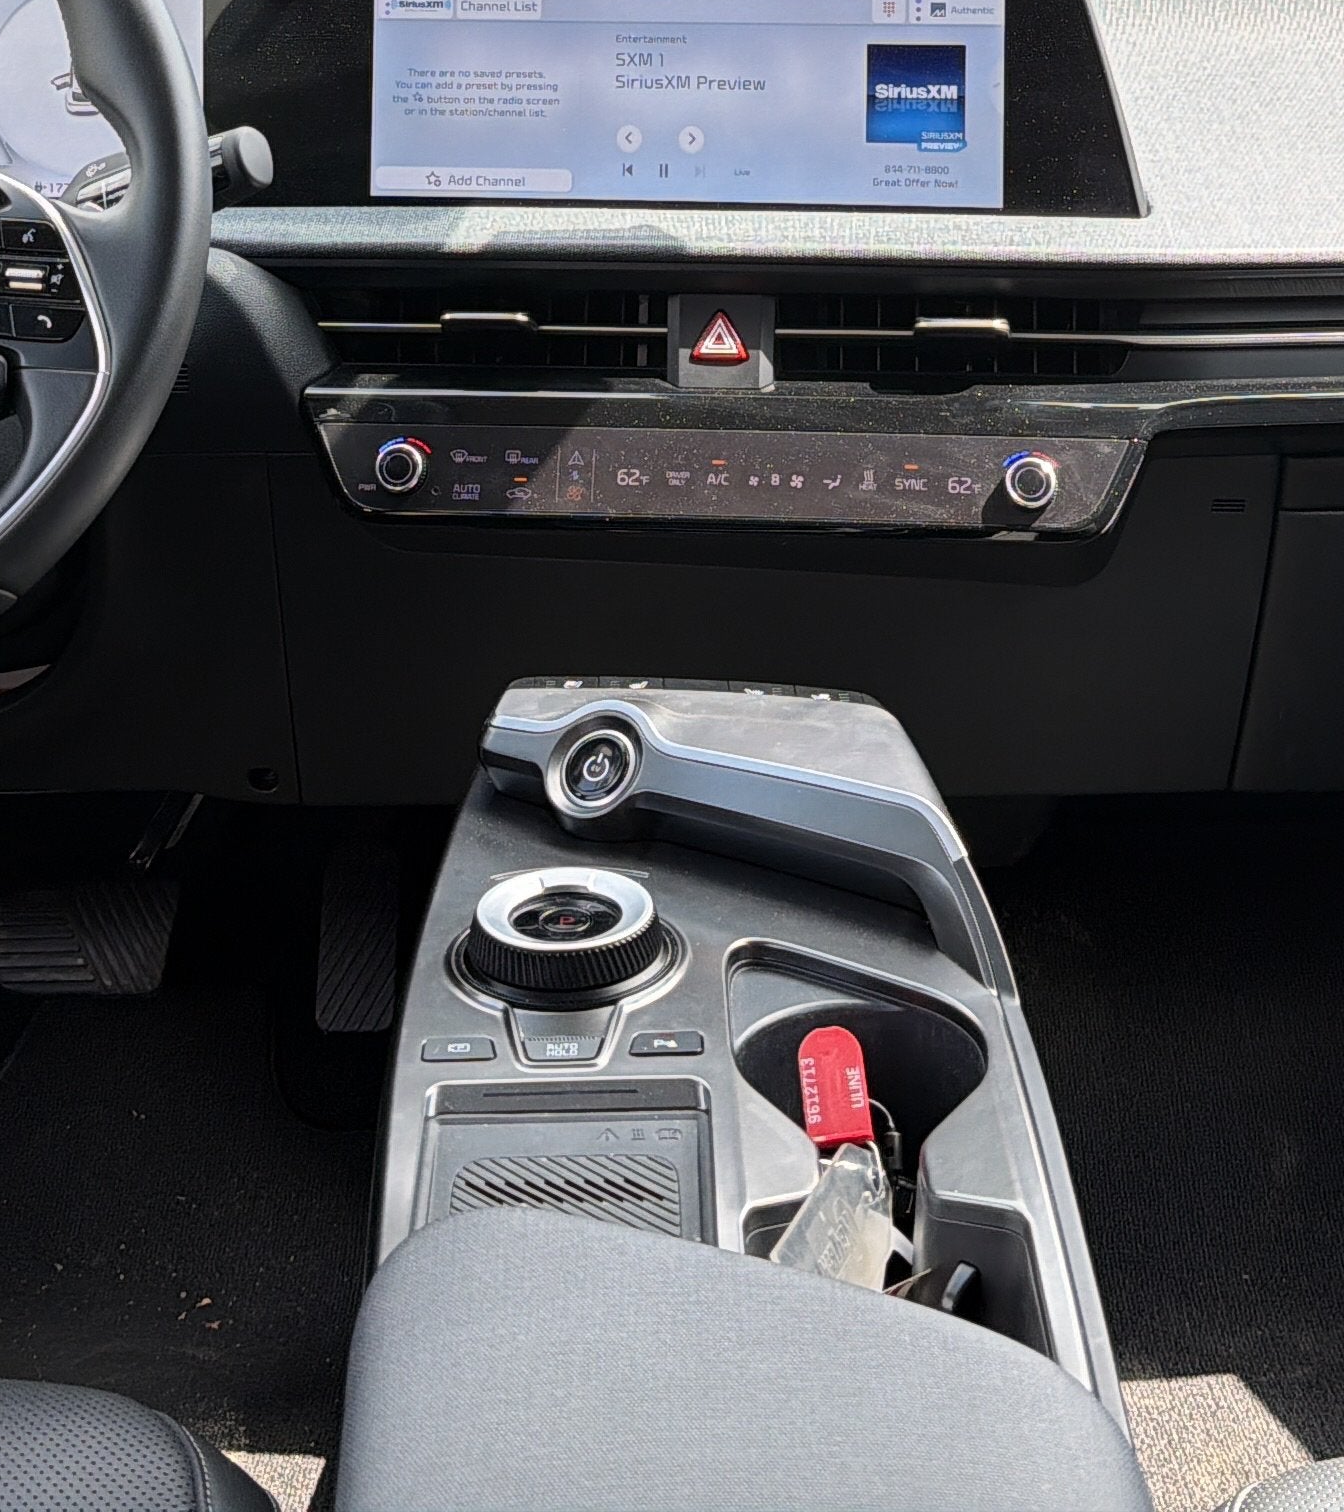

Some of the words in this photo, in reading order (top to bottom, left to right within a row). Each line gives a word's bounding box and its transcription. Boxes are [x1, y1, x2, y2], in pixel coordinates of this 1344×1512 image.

[460, 0, 511, 13] Channel
[513, 0, 538, 13] List
[950, 6, 996, 16] Authentic
[615, 34, 688, 45] Entertainment
[615, 52, 654, 68] SXM
[658, 52, 665, 68] 1
[408, 67, 437, 78] There
[439, 70, 456, 79] are
[458, 70, 471, 79] no
[473, 69, 503, 79] saved
[504, 70, 546, 80] presets.
[395, 79, 413, 90] You
[415, 81, 433, 90] can
[435, 80, 454, 90] add
[464, 81, 499, 92] preset
[500, 81, 513, 92] by
[515, 82, 559, 93] pressing
[615, 74, 692, 91] SiriusXM
[696, 75, 767, 91] Preview
[874, 83, 959, 100] SiriusXM
[392, 94, 409, 104] the
[427, 94, 461, 105] button
[463, 97, 476, 106] on
[478, 96, 495, 106] the
[497, 96, 524, 106] radio
[526, 98, 560, 106] screen
[404, 108, 417, 116] or
[419, 107, 428, 116] in
[430, 107, 447, 117] the
[448, 107, 527, 118] station/channel
[529, 108, 548, 118] list.
[921, 131, 963, 141] SIRIUSXM
[448, 175, 474, 188] Add
[475, 175, 527, 189] Channel
[872, 177, 903, 188] Great
[904, 177, 931, 188] Offer
[933, 178, 959, 189] Now!
[706, 471, 731, 487] A/C
[894, 477, 929, 492] SYNC
[452, 483, 482, 494] AUTO
[560, 916, 576, 926] P
[546, 1043, 579, 1051] AUTO
[546, 1050, 578, 1058] HOLD
[845, 1065, 866, 1109] ULINE
